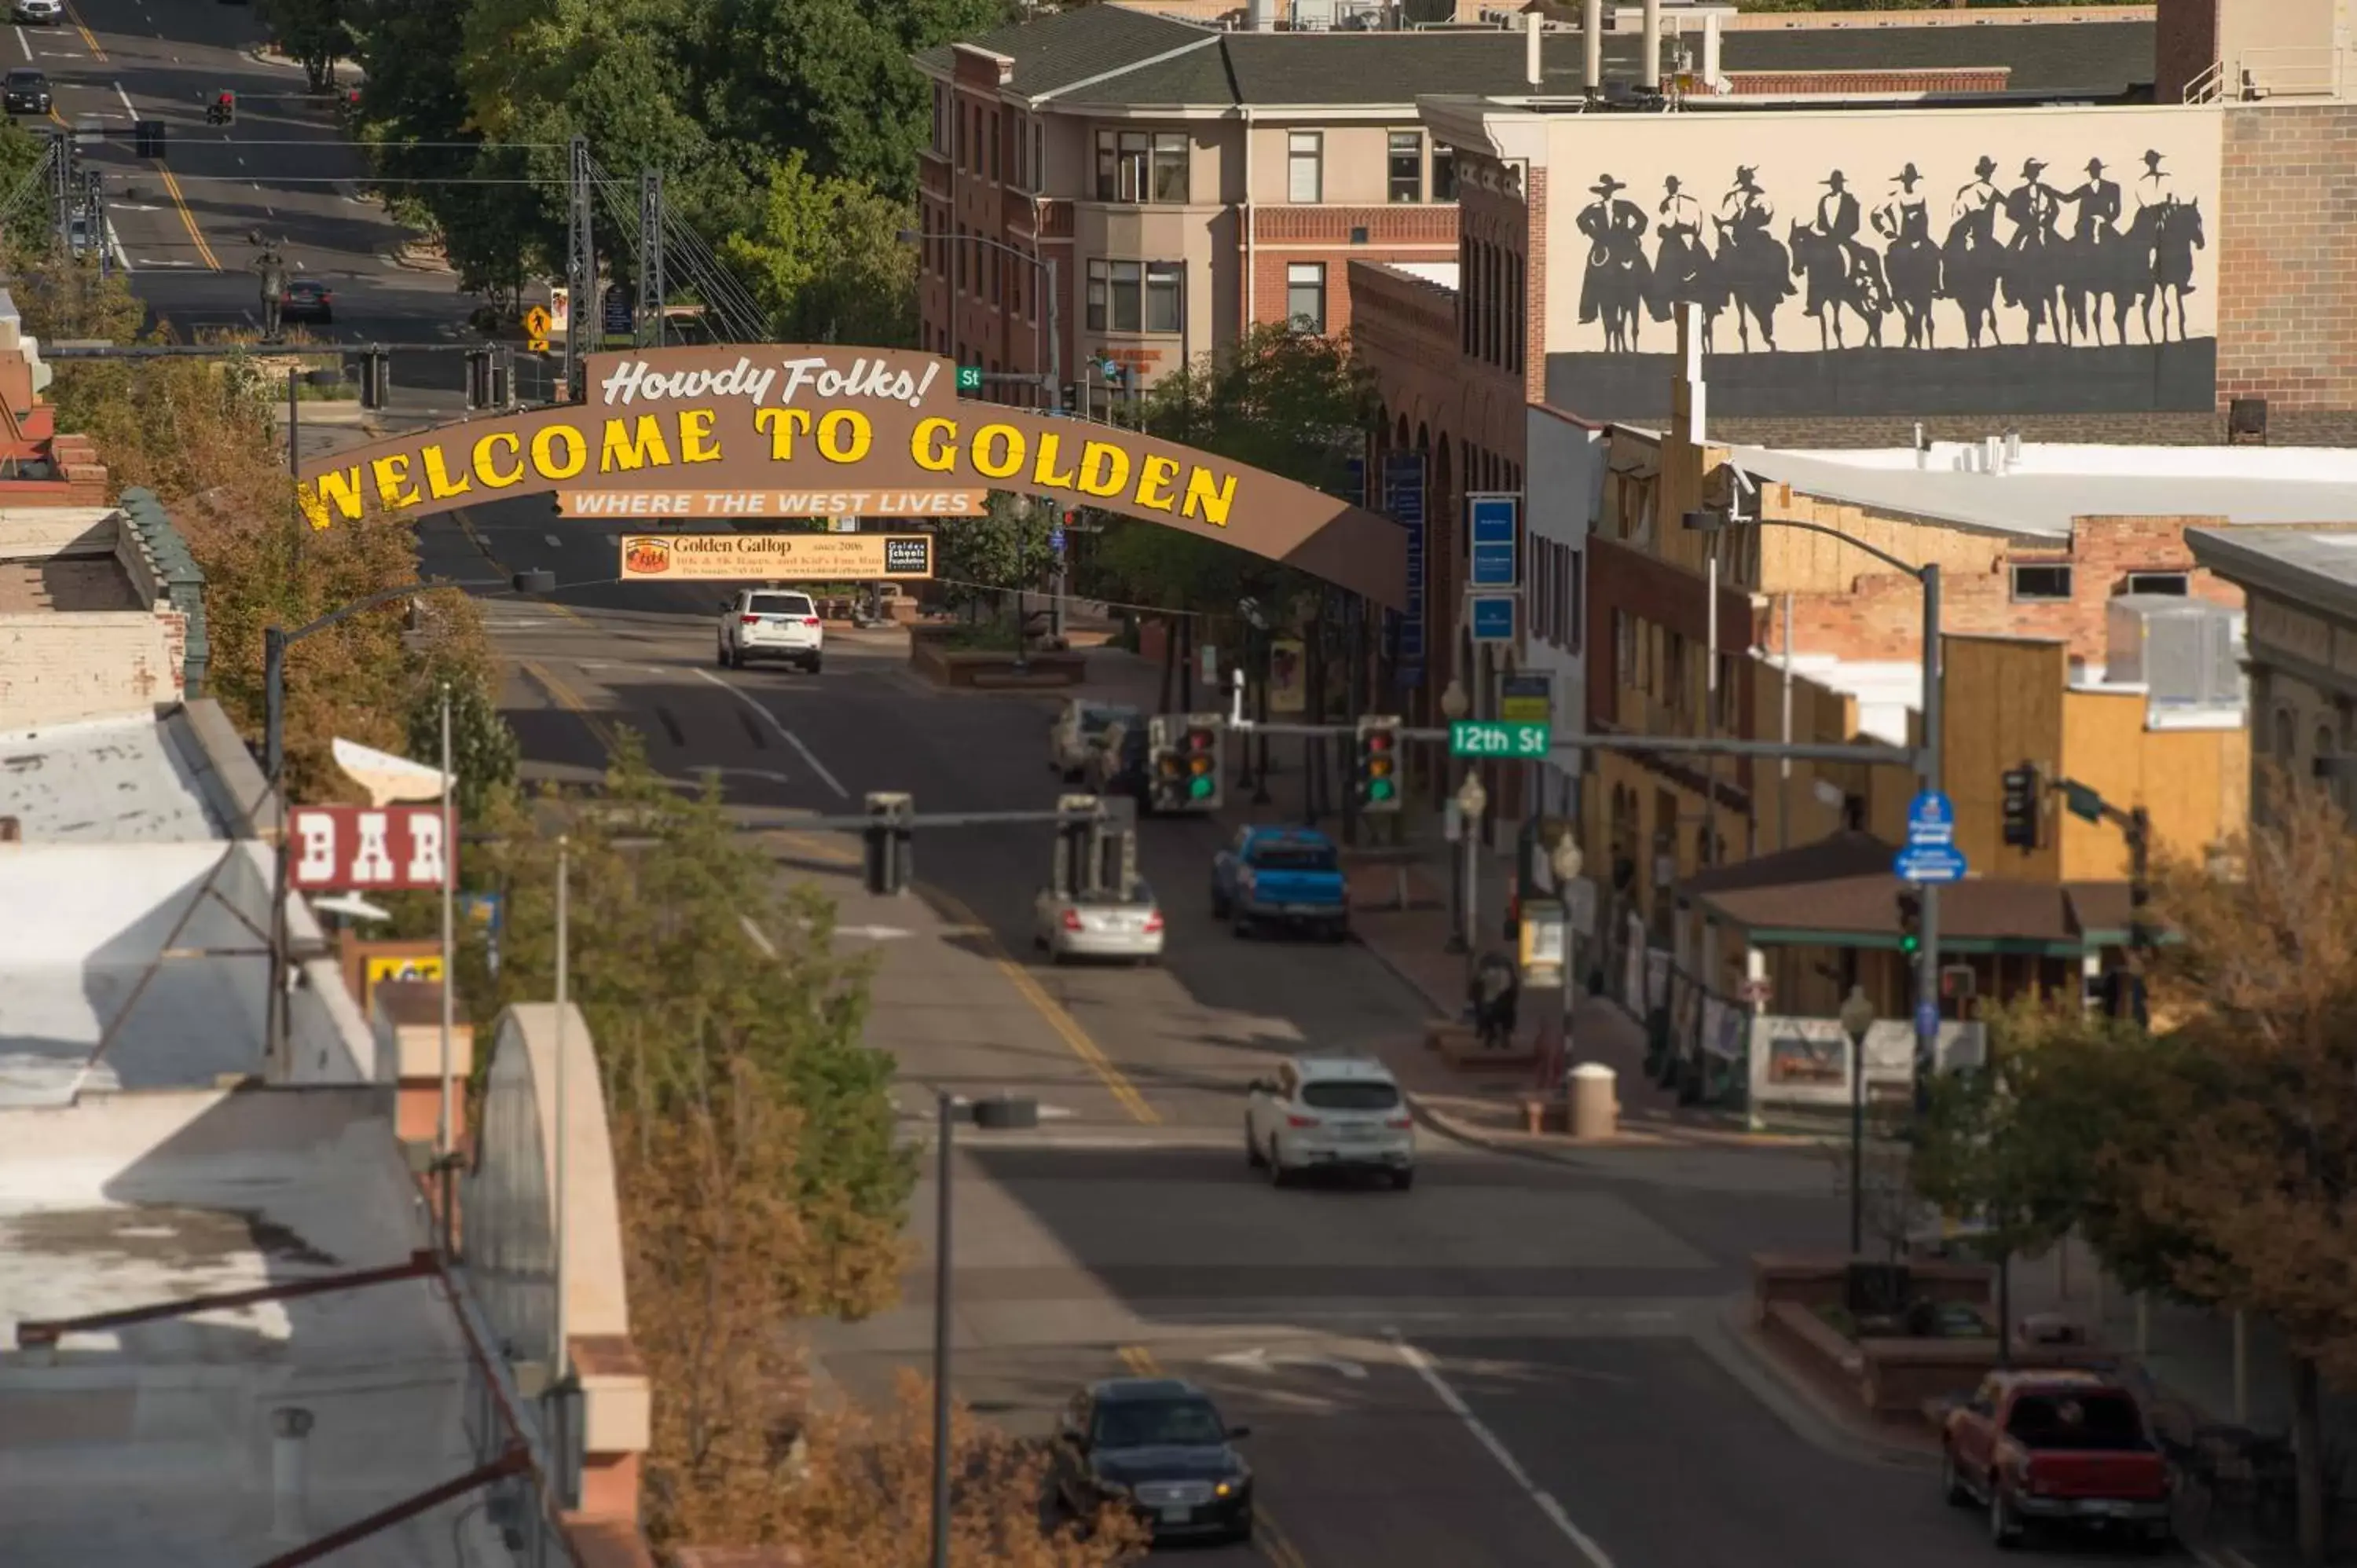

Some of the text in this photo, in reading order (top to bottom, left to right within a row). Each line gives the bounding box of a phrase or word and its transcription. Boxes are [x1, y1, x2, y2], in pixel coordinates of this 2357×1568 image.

[602, 357, 940, 408] Howdy Folks!
[962, 369, 979, 386] St
[297, 407, 1238, 529] WELCOME TO GOLDEN
[575, 493, 970, 515] WHERE THE WEST LIVES
[673, 537, 732, 553] Golden
[736, 537, 792, 556] Gallop
[1455, 727, 1544, 752] 12th St
[298, 811, 449, 883] BAR
